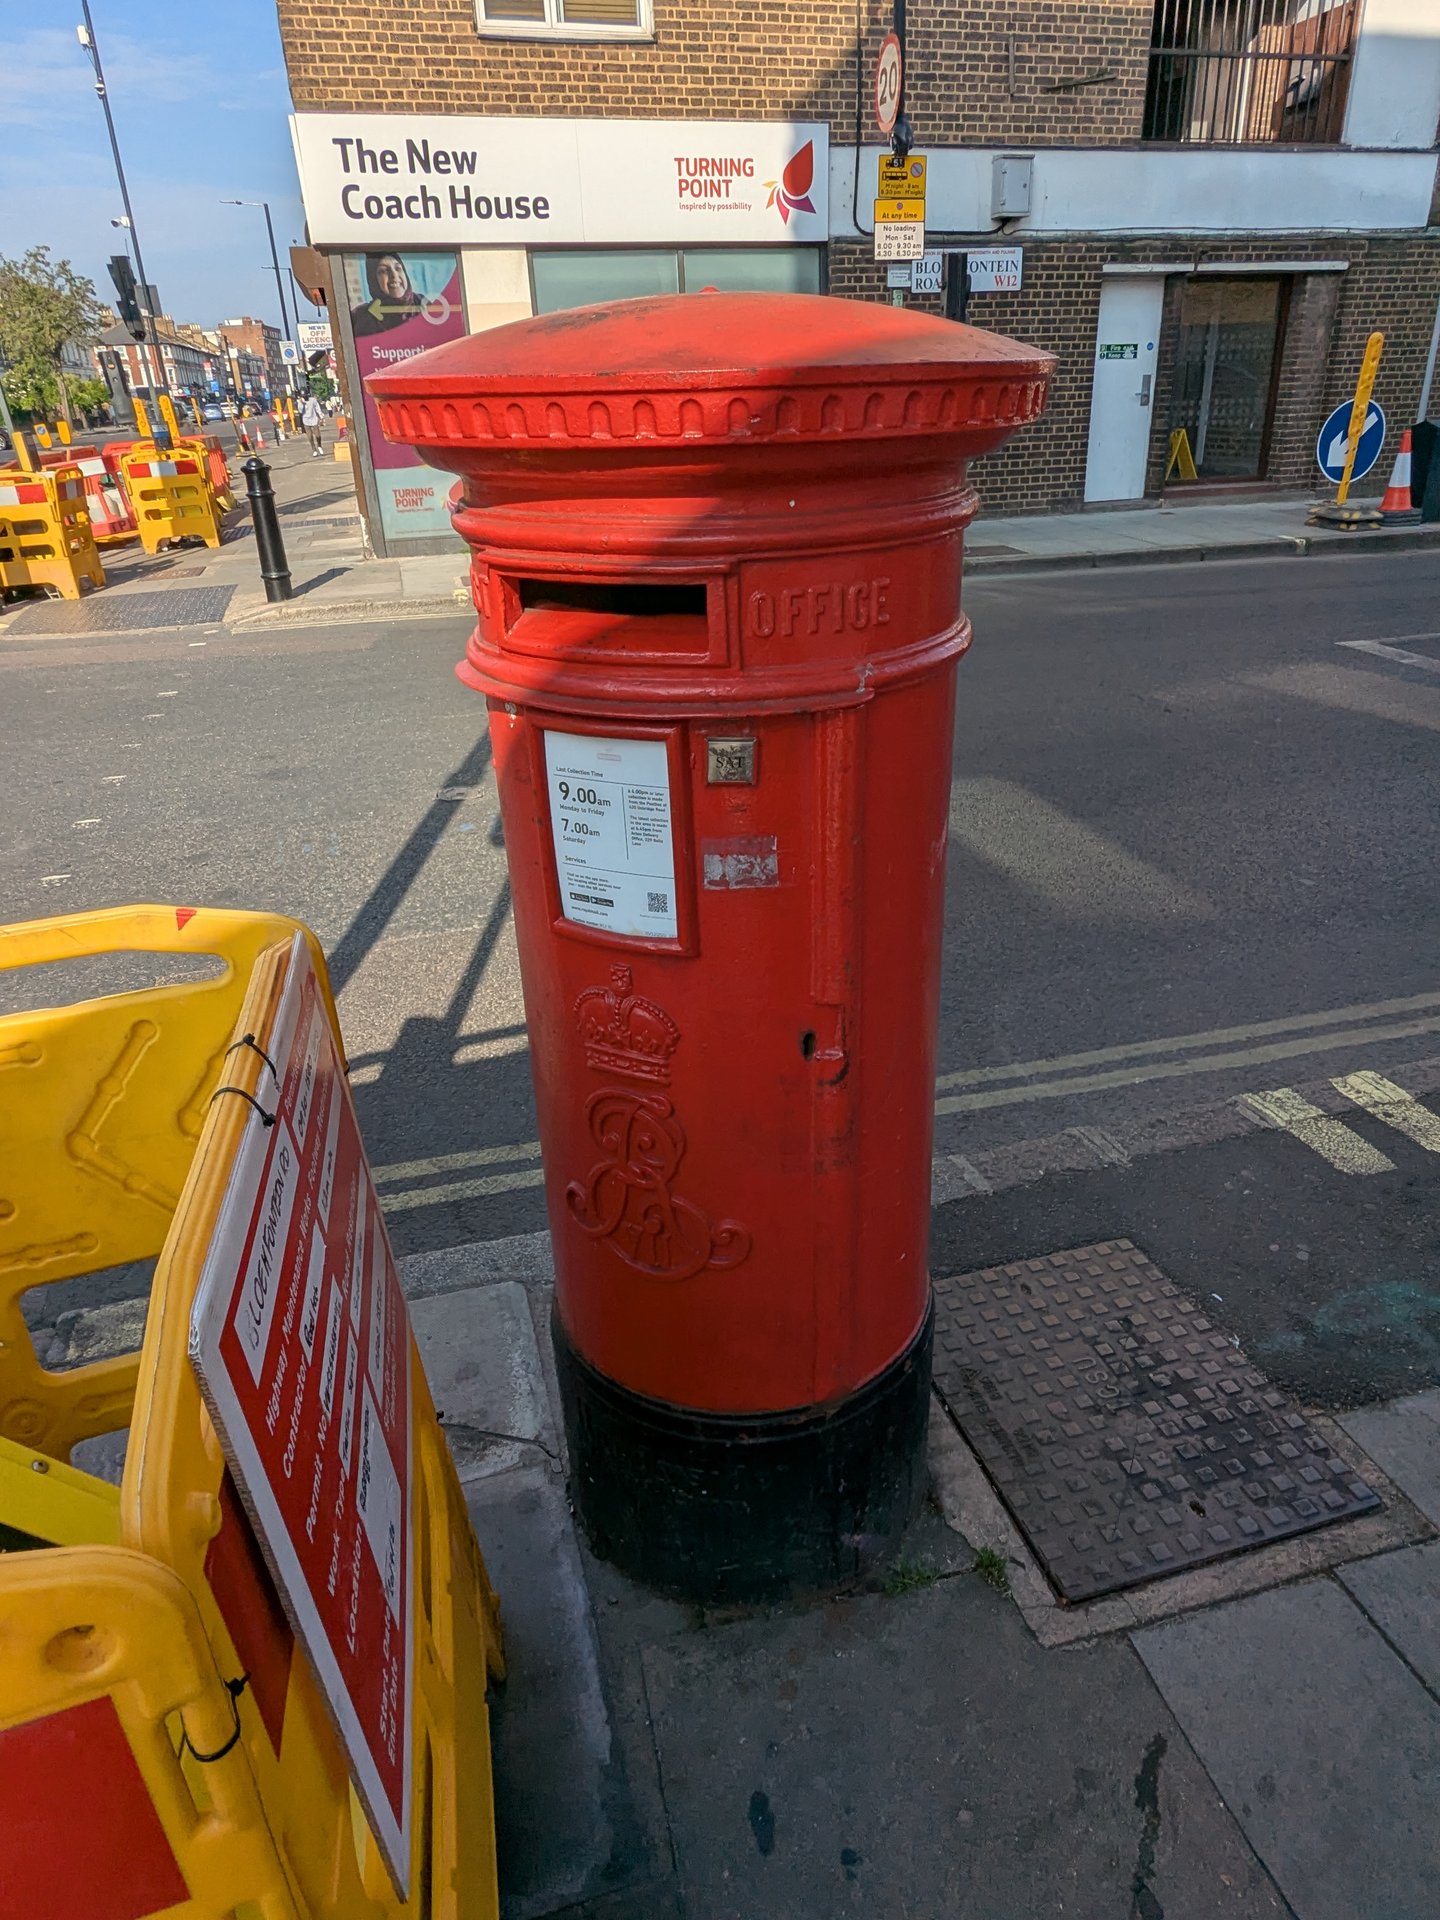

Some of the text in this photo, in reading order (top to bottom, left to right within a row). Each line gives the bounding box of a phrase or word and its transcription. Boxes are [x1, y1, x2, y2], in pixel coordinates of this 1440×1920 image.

[879, 61, 898, 107] 20
[332, 137, 478, 175] The New
[674, 157, 754, 177] TURNING
[678, 179, 732, 198] POINT
[341, 184, 550, 220] Coach House
[679, 202, 752, 212] inspired by possibility
[894, 225, 916, 233] loading
[915, 260, 1019, 274] BLOONTEIN
[994, 274, 1017, 287] W12
[392, 488, 434, 498] TURNING
[395, 497, 423, 508] POINT
[750, 577, 890, 638] OFFICE
[566, 767, 590, 776] Collection
[715, 756, 745, 769] SAT
[557, 780, 611, 807] 9.00am
[559, 803, 579, 813] Monday
[587, 807, 605, 816] Friday
[560, 817, 600, 837] 7.00am
[562, 835, 586, 845] Saturday
[564, 855, 586, 864] Services
[265, 1192, 311, 1434] Highway Maintenance Works
[282, 1355, 306, 1477] Contractor
[305, 1413, 327, 1542] Permit No
[327, 1467, 345, 1596] Work Type
[346, 1523, 362, 1652] Location
[379, 1594, 391, 1740] Start Date
[387, 1656, 398, 1765] End Date
